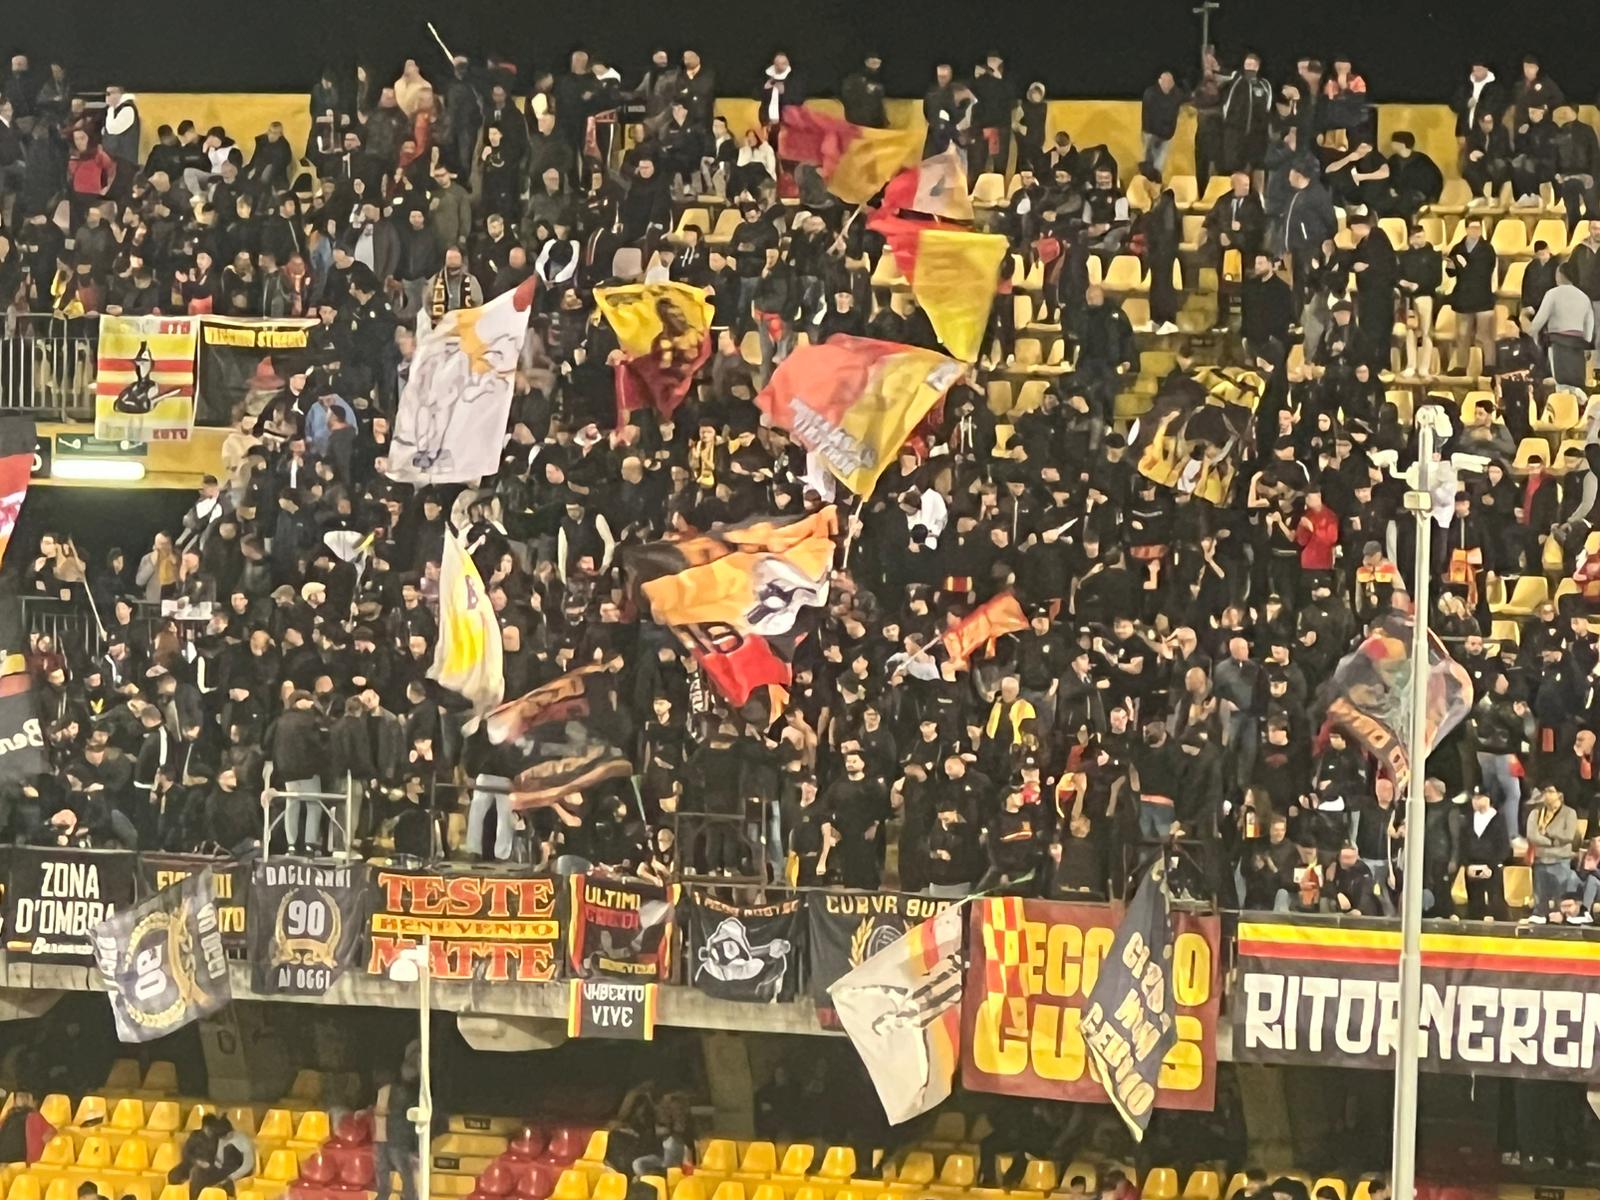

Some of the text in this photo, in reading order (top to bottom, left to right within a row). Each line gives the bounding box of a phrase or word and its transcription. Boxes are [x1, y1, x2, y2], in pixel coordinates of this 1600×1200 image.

[40, 862, 100, 899] ZONA
[266, 865, 311, 886] DAGLI
[378, 872, 555, 918] TESTE
[585, 884, 641, 911] ULTIMI
[826, 895, 898, 914] CURVA
[287, 900, 325, 936] 90
[297, 969, 331, 989] OGGI
[592, 1006, 634, 1028] VIVE
